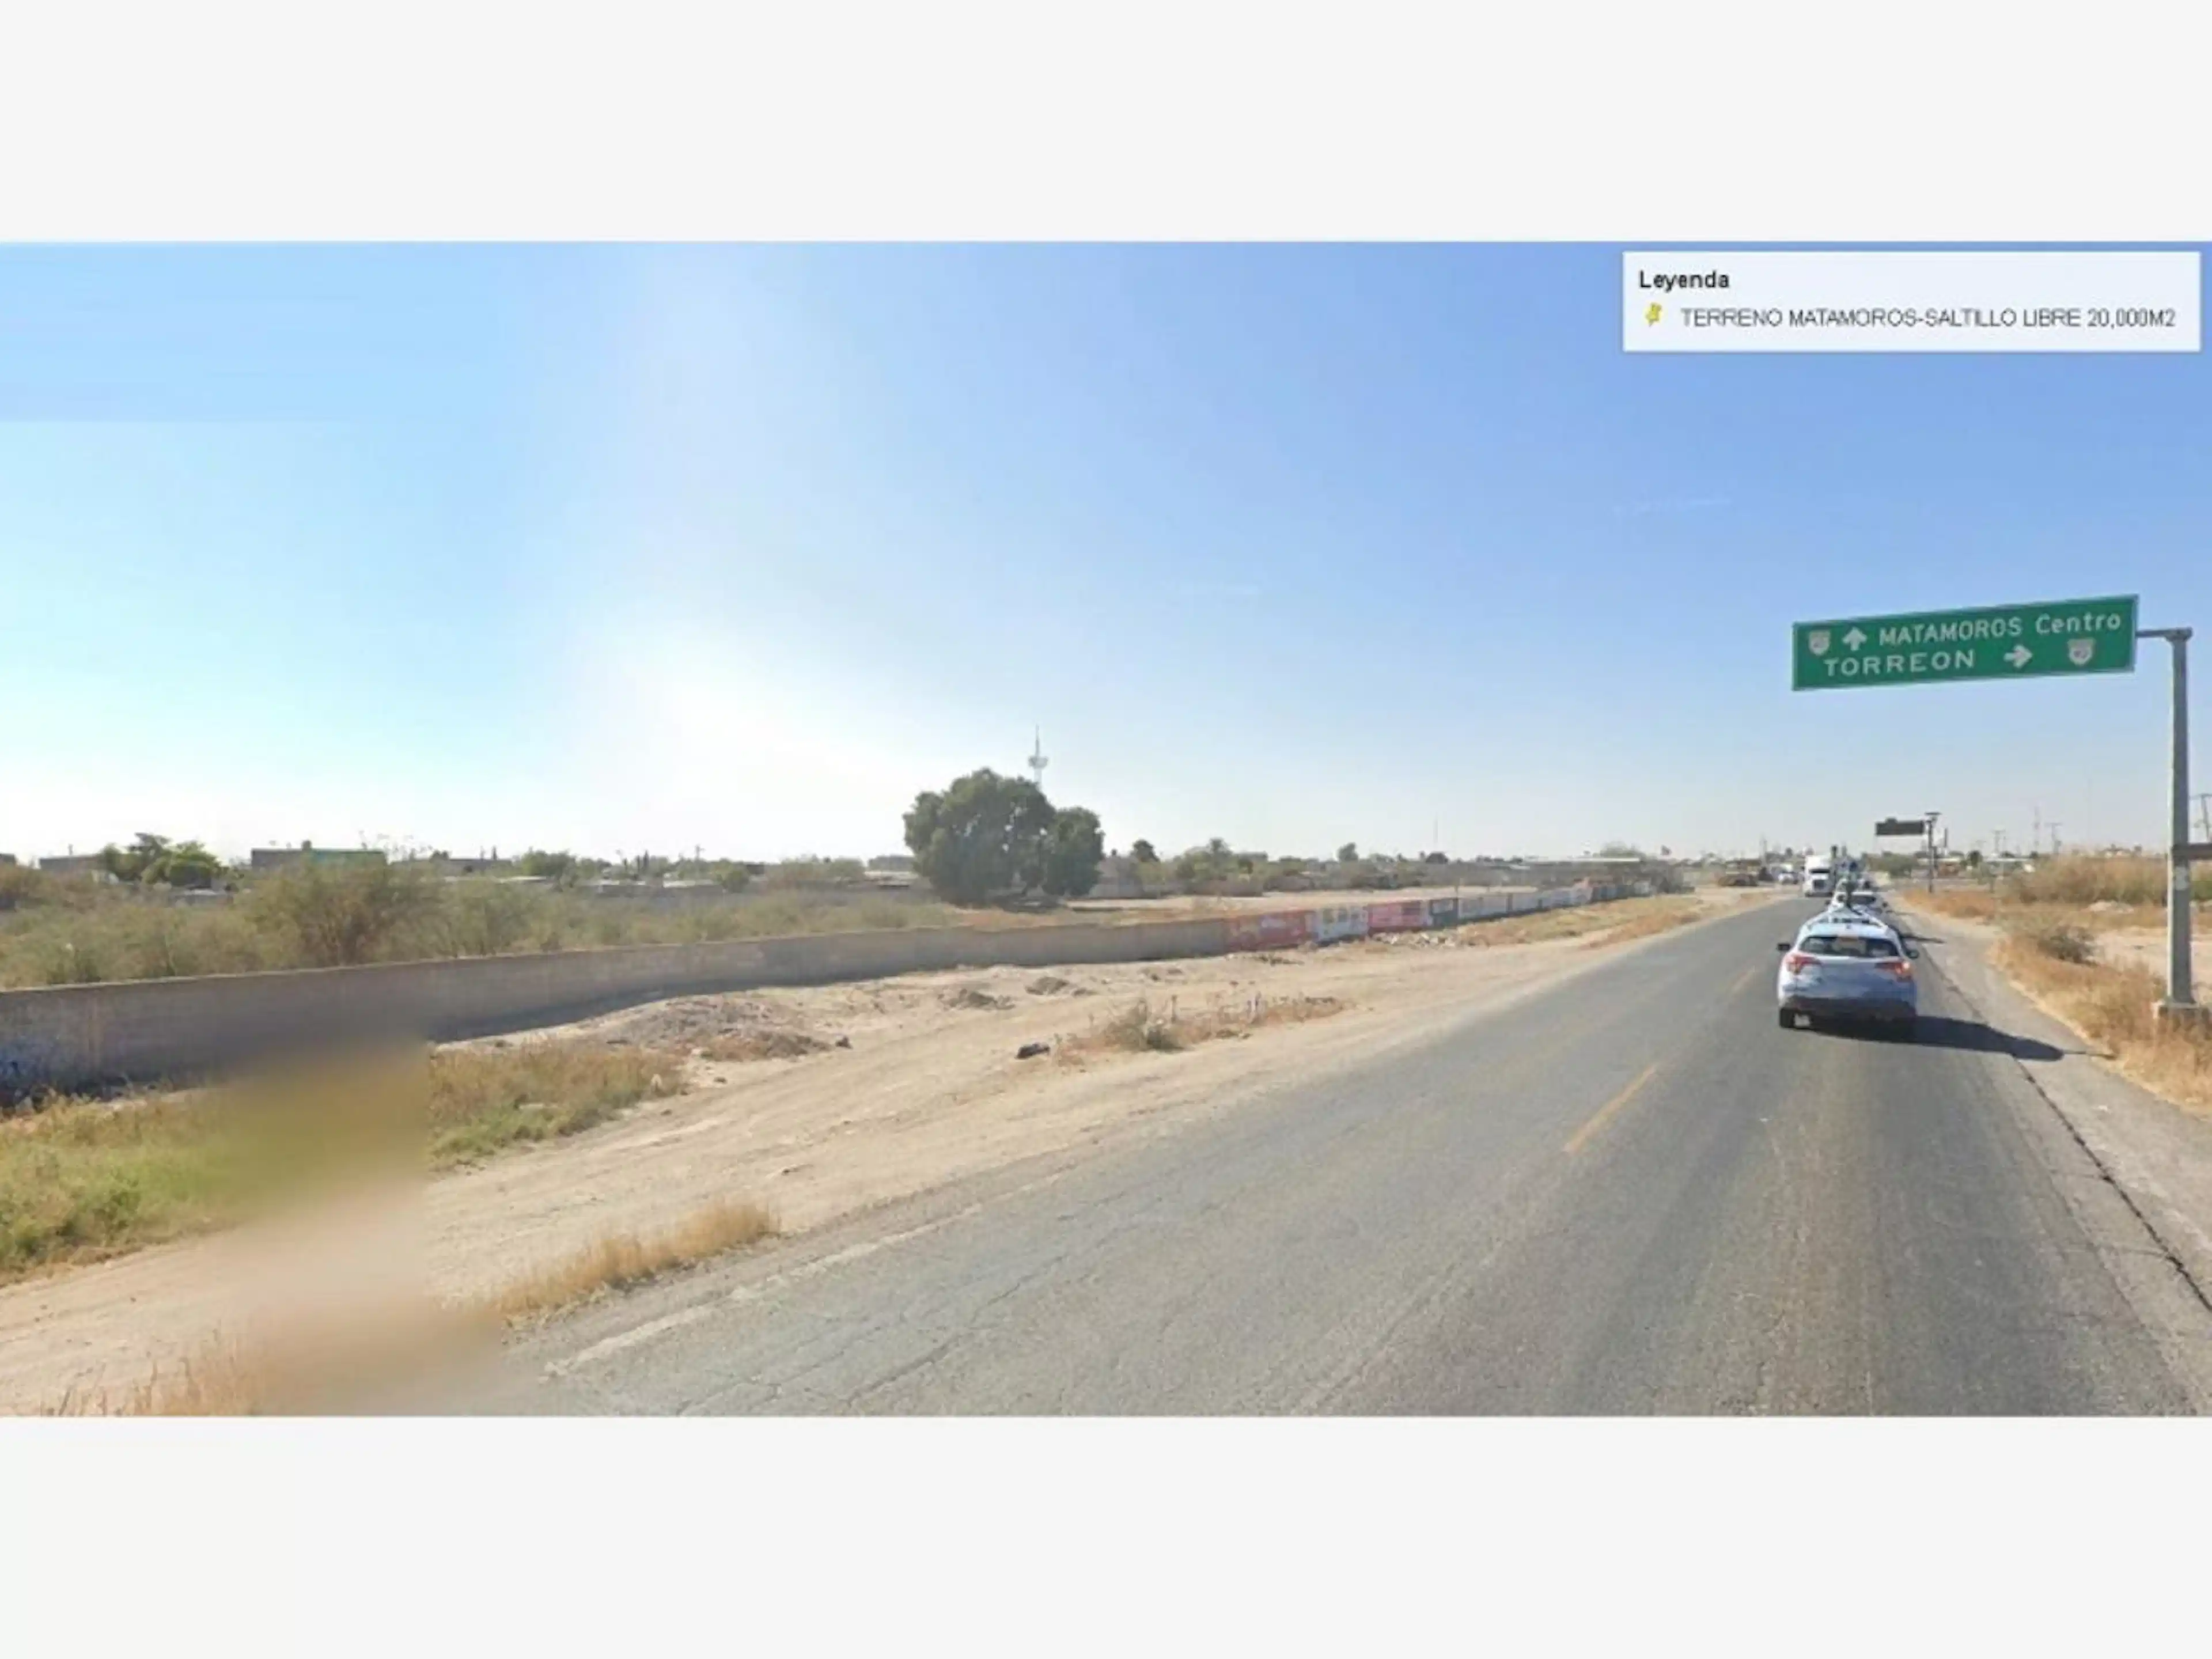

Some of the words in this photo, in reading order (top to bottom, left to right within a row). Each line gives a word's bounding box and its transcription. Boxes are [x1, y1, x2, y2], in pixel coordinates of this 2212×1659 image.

[1879, 618, 2022, 646] MATAMOROS
[2035, 612, 2122, 634] Centro
[1824, 649, 1976, 677] TORREON
